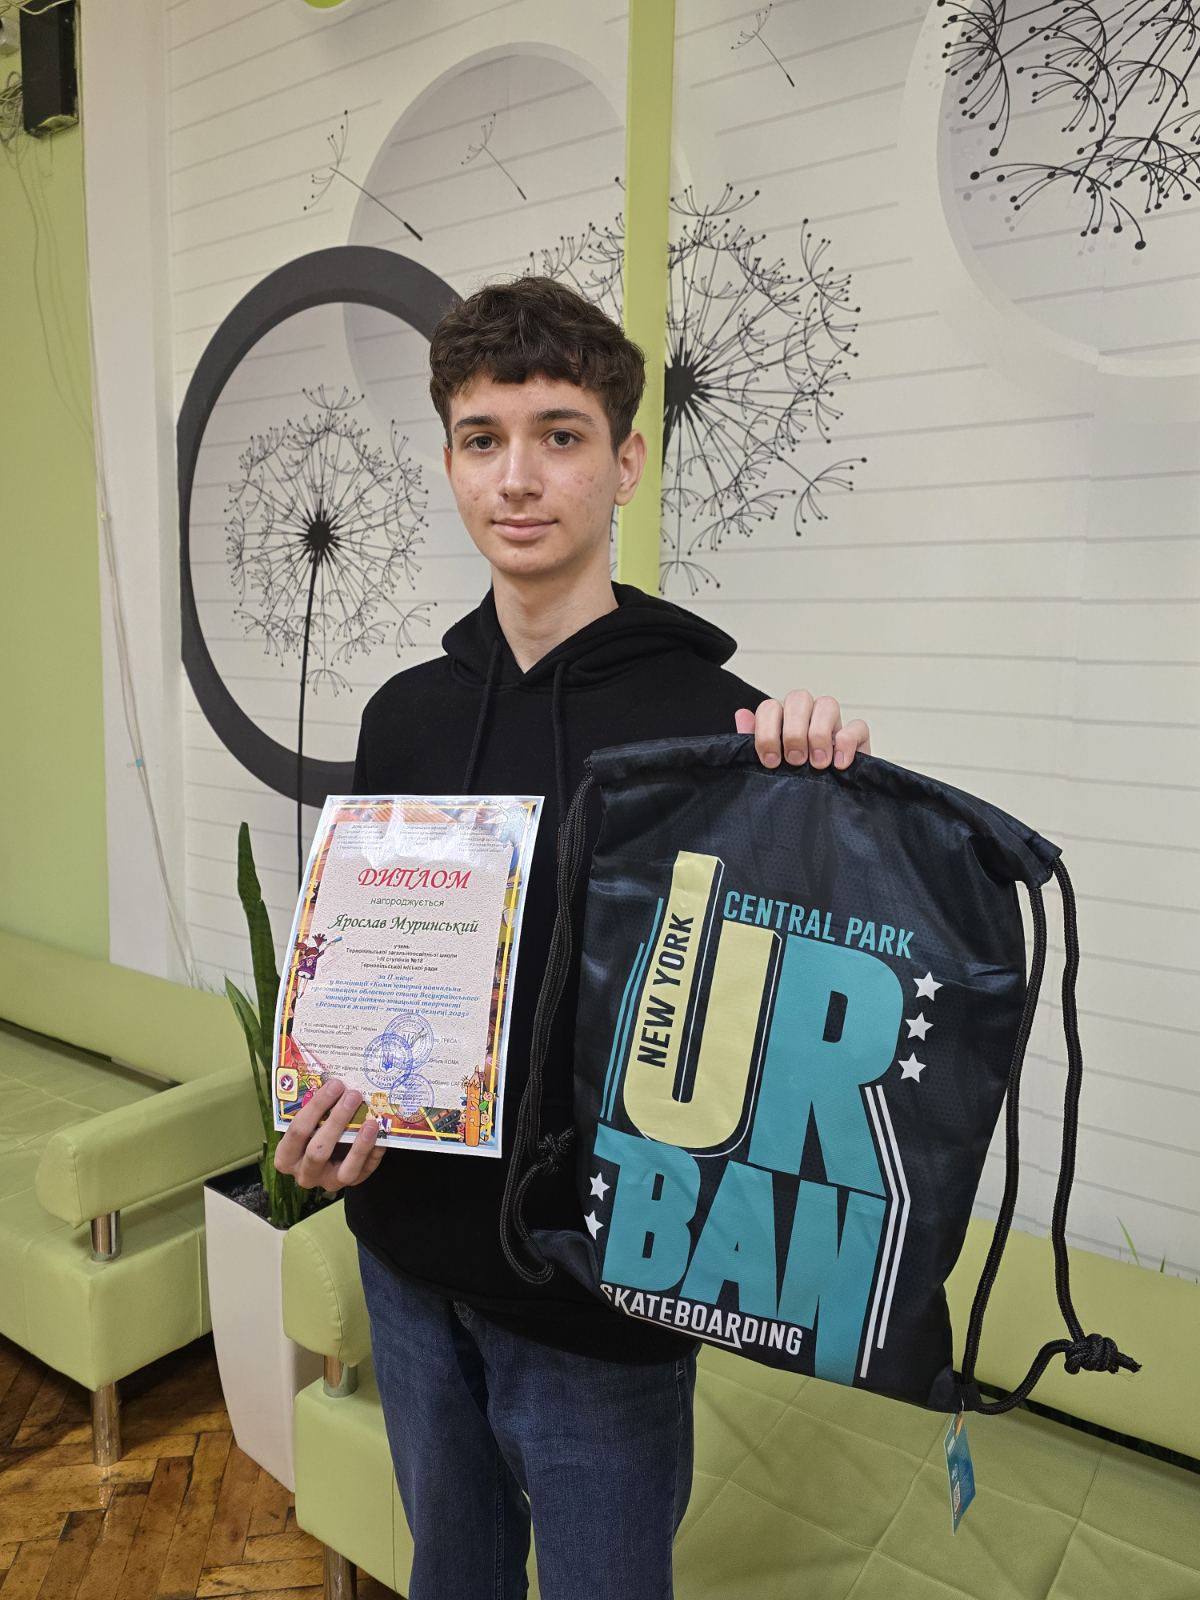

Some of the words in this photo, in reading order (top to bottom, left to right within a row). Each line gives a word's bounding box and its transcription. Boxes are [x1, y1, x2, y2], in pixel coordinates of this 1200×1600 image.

[357, 867, 472, 890] ДИПЛОМ
[370, 897, 445, 907] нагороджується
[327, 914, 387, 932] Ярослав
[389, 916, 480, 936] Муринський
[652, 912, 694, 987] YORK
[723, 890, 836, 942] CENTRAL
[844, 916, 915, 960] PARK
[636, 994, 676, 1069] NEW
[599, 1283, 803, 1356] SKATEBOARDING
